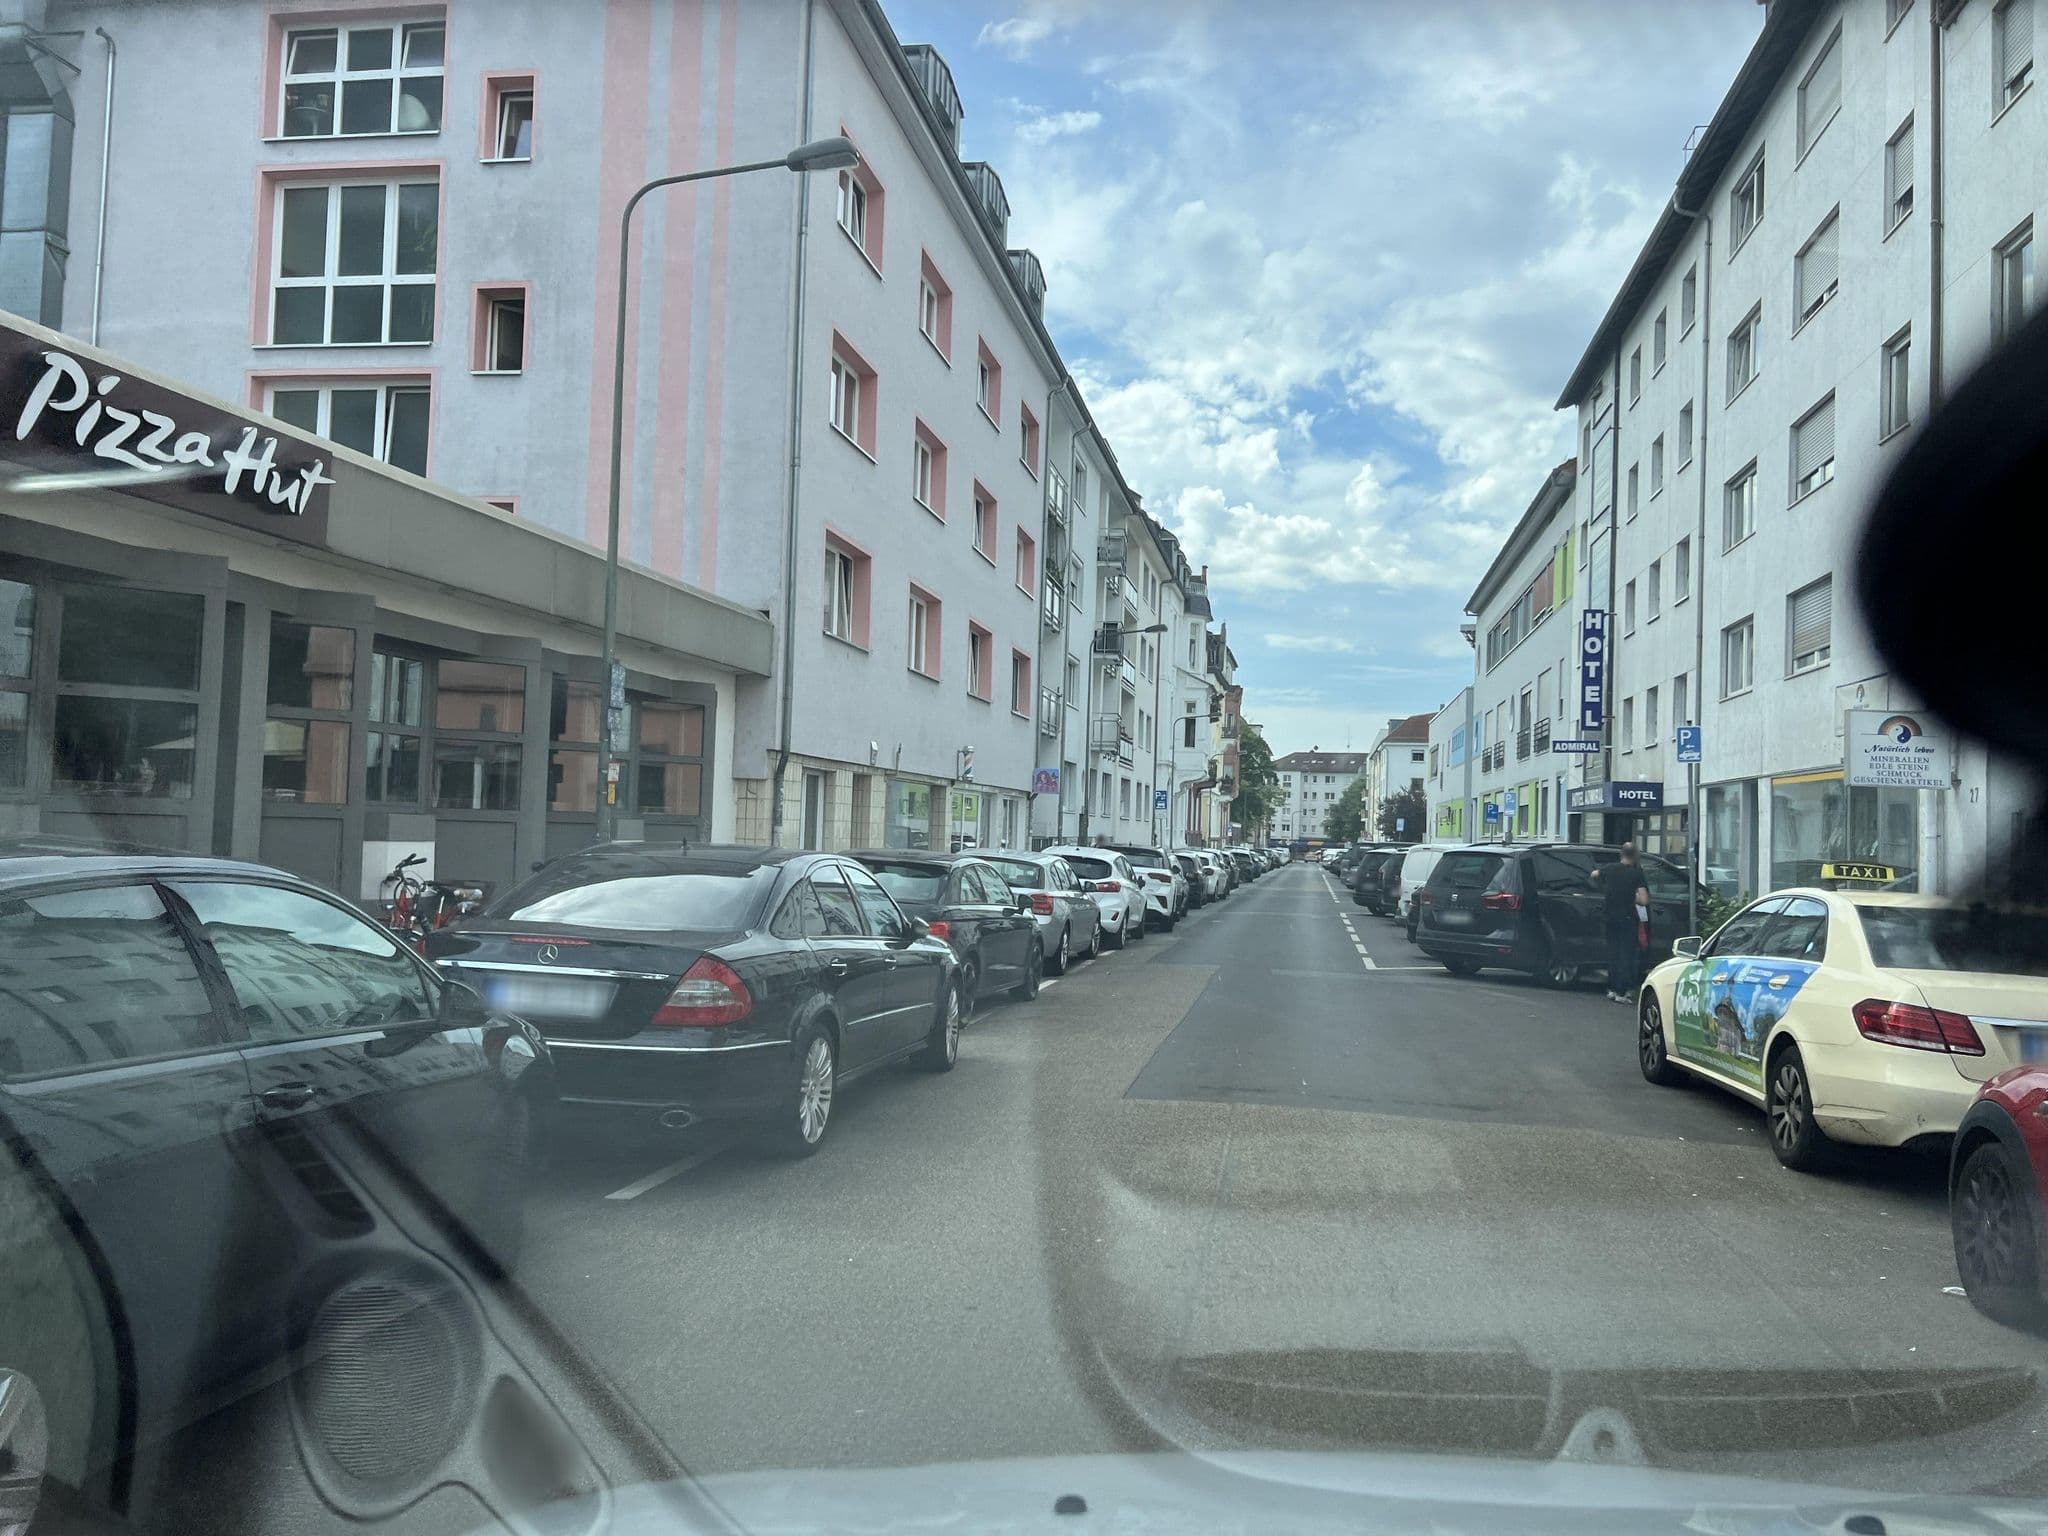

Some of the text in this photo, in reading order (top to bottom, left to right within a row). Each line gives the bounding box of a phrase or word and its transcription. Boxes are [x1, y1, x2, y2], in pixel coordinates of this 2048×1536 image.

[16, 352, 337, 515] Pizza Hut
[1584, 612, 1602, 727] HOTEL
[1680, 729, 1692, 746] P
[1554, 742, 1599, 751] ADMIRAL
[1864, 744, 1911, 754] Natürlich
[1870, 755, 1930, 764] MINERALIEN
[1897, 763, 1929, 771] STEINE
[1876, 770, 1922, 778] SCHMUCK
[1853, 776, 1945, 787] GESCHENKARTIKEL
[1619, 789, 1657, 800] HOTEL
[1840, 866, 1880, 878] TAXI
